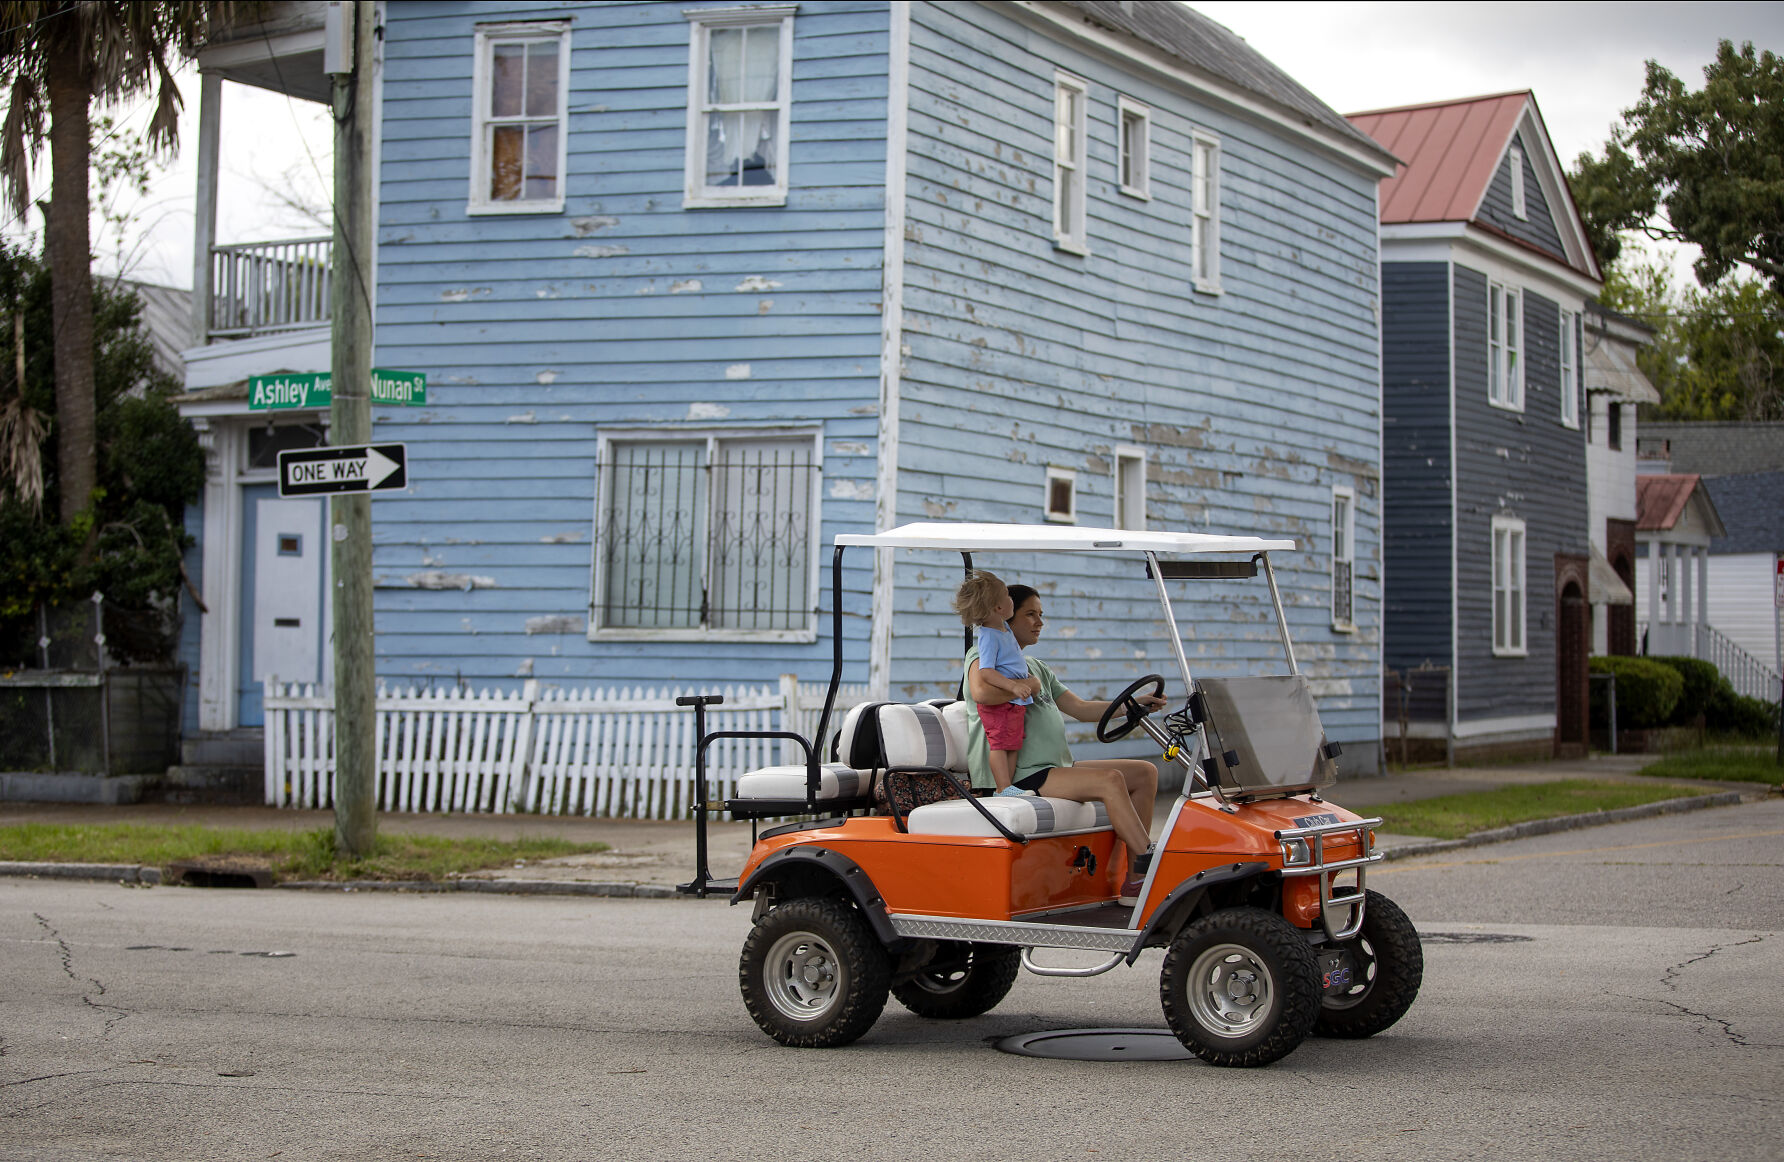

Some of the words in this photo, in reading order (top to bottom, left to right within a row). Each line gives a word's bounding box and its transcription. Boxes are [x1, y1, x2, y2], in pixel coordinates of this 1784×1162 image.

[253, 379, 309, 406] Ashley
[313, 376, 332, 392] Ave
[370, 373, 412, 400] Nunan
[413, 376, 424, 393] St
[292, 462, 327, 482] ONE
[332, 460, 367, 479] WAY
[1322, 967, 1350, 989] SGC
